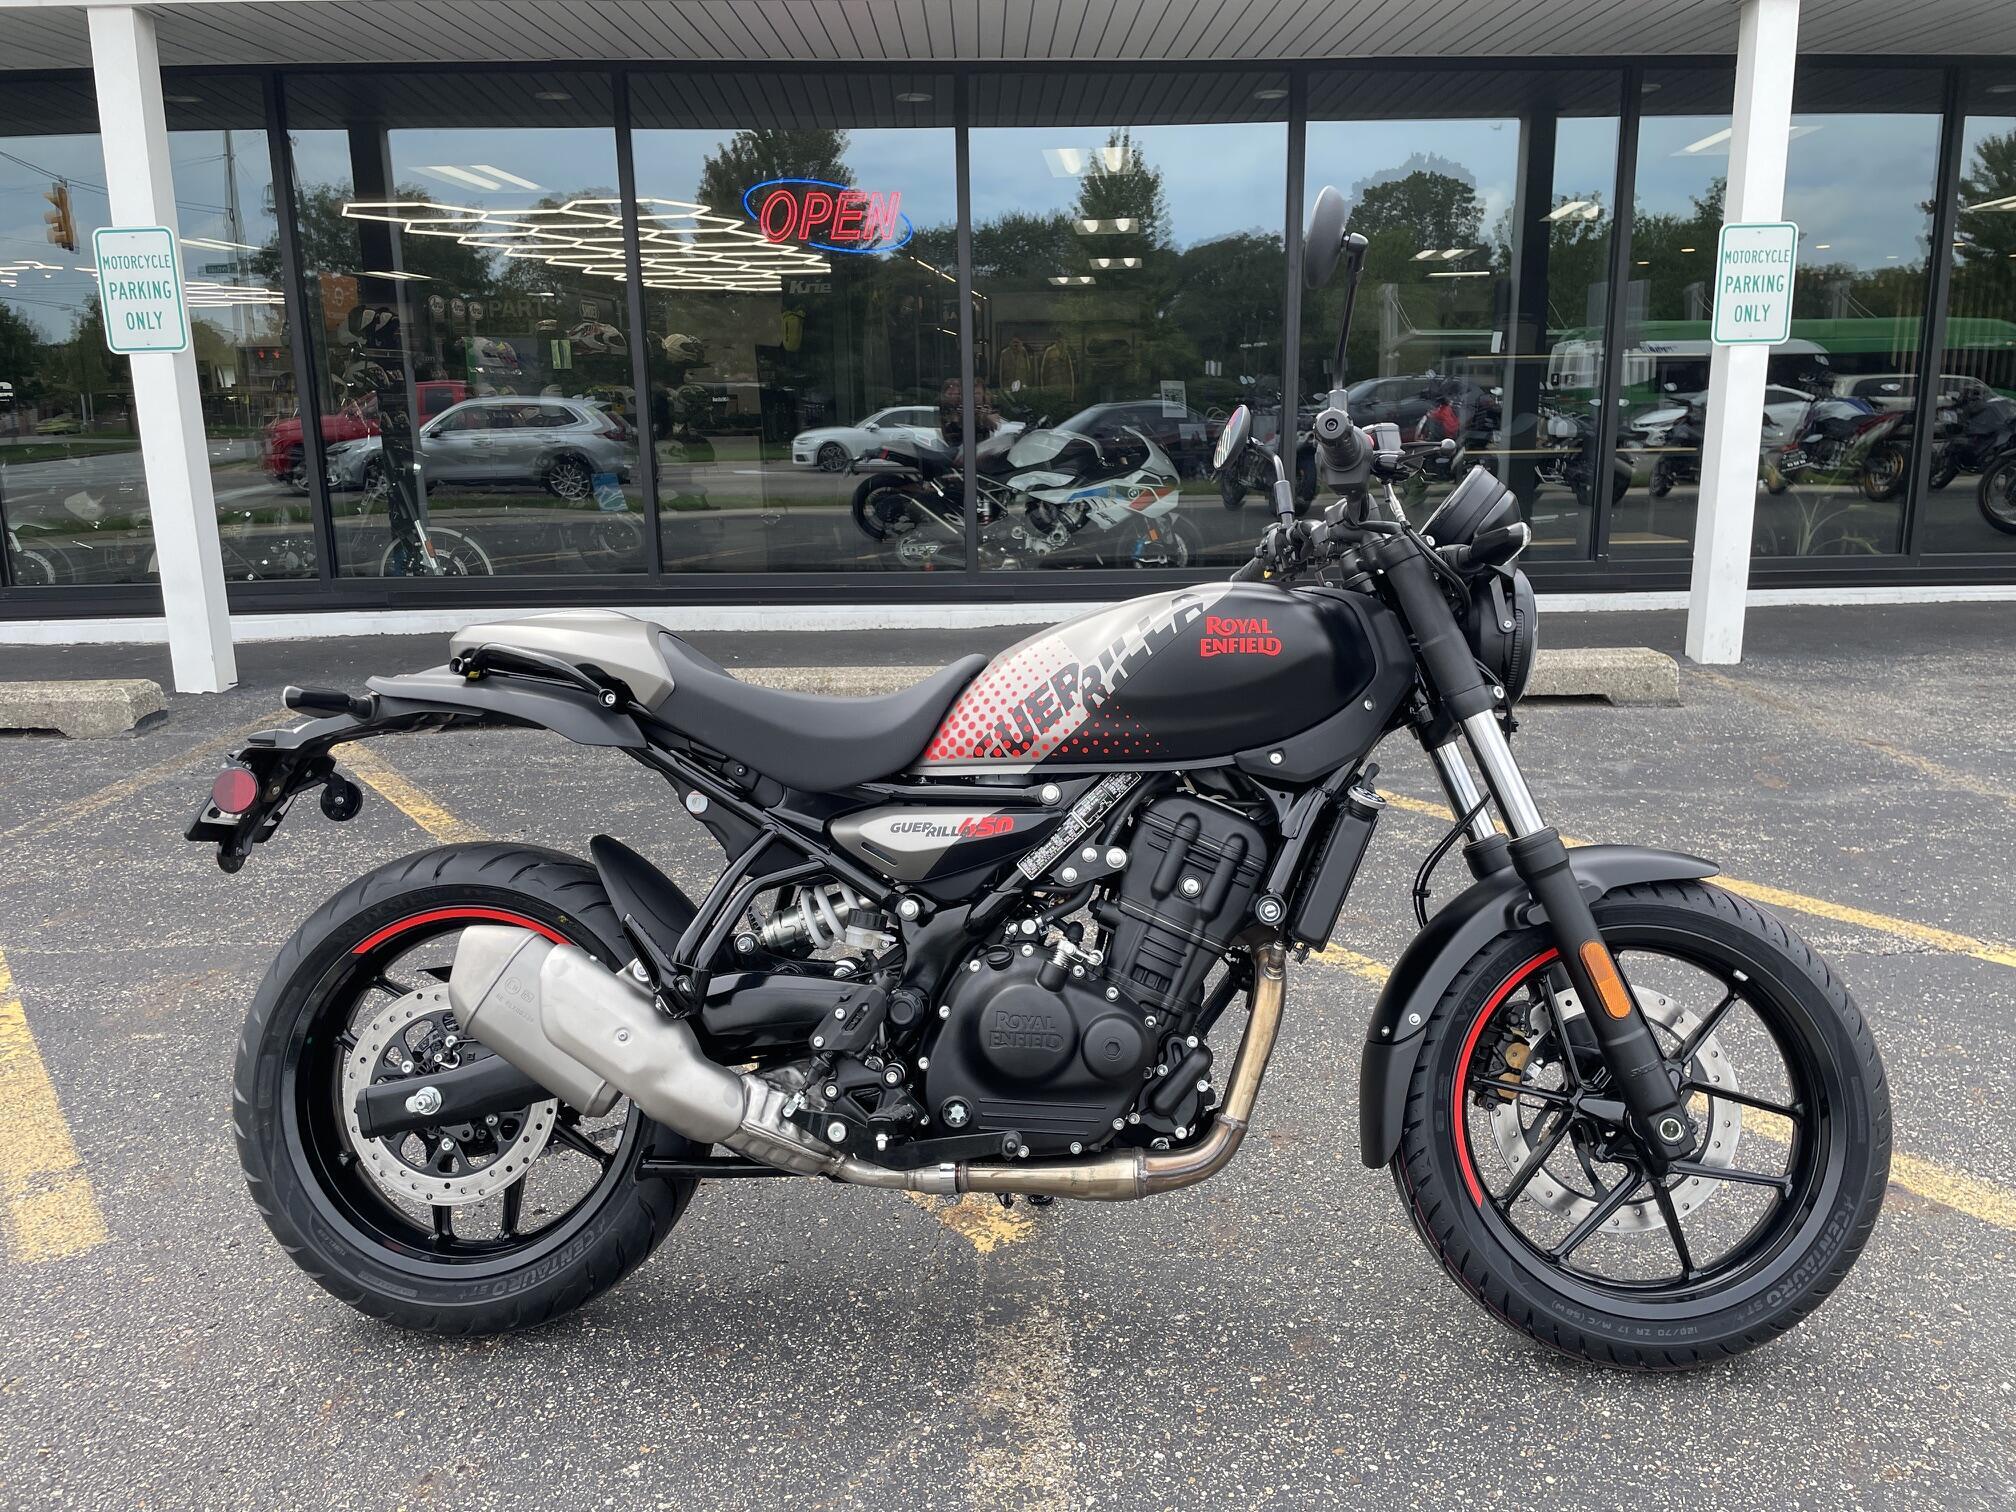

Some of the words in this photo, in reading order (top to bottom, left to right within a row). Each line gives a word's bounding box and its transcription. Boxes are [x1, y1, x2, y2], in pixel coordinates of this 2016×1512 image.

[760, 189, 902, 243] OPEN
[102, 254, 171, 270] MOTORCYCLE
[1724, 249, 1791, 265] MOTORCYCLE
[109, 280, 172, 300] PARKING
[1725, 274, 1785, 294] PARKING
[125, 311, 163, 330] ONLY
[1734, 303, 1771, 323] ONLY
[1205, 615, 1273, 636] ROYAL
[1200, 637, 1282, 657] ENFIELD
[890, 821, 974, 838] GUERRILLA
[957, 815, 1015, 839] 450
[995, 1010, 1056, 1030] ROYAL
[989, 1030, 1064, 1052] ENFIELD
[492, 1229, 596, 1296] CENTAURO
